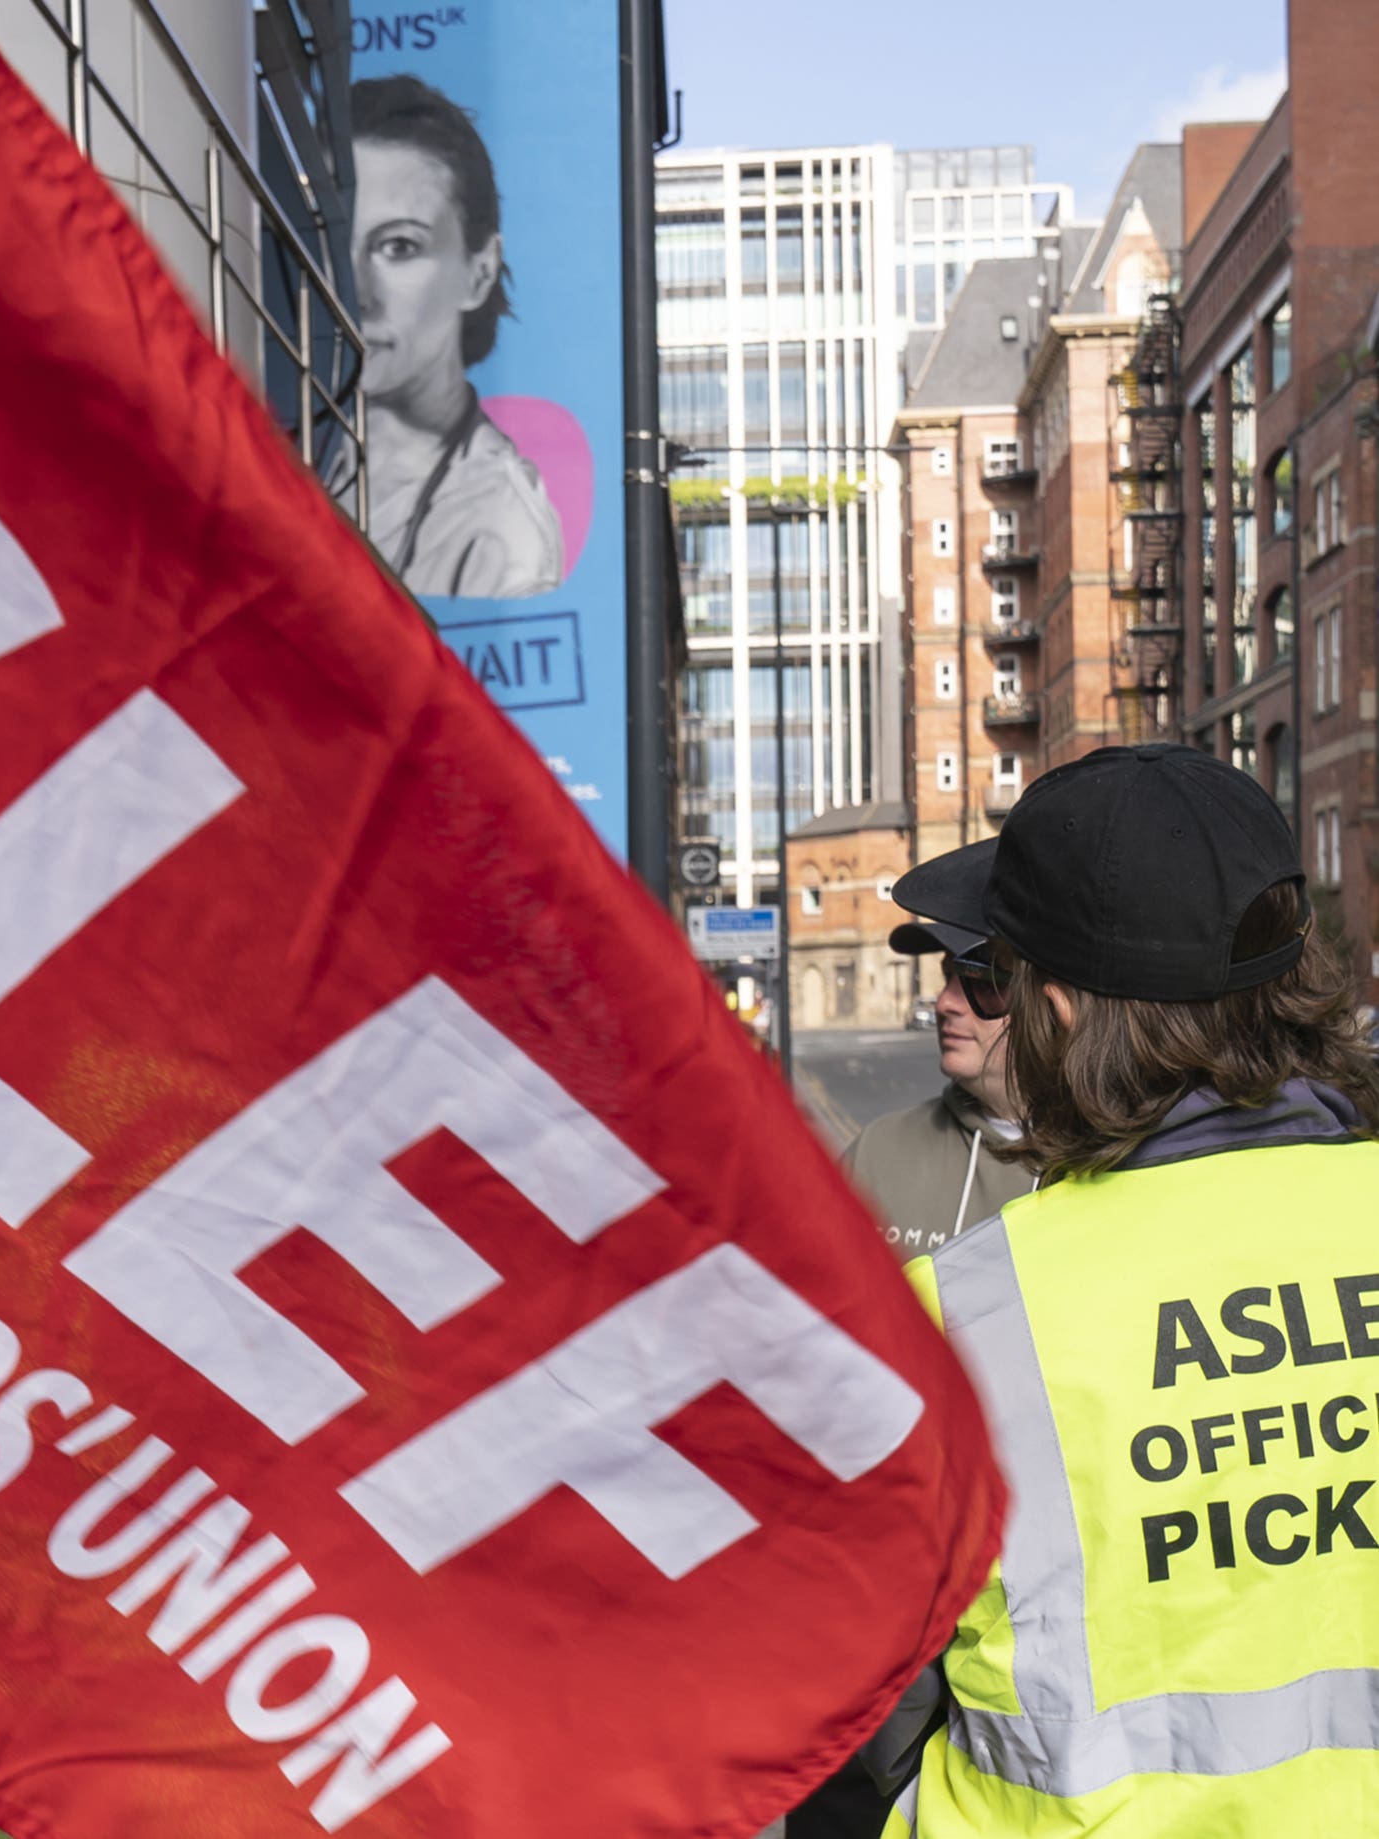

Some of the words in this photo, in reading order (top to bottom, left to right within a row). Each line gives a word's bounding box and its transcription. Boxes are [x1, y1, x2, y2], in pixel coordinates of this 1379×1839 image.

[466, 637, 561, 688] AIT
[877, 1226, 946, 1249] OMM
[1152, 1273, 1379, 1390] ASLE
[1130, 1392, 1379, 1483] OFFIC
[1141, 1480, 1379, 1583] PICK
[47, 1435, 453, 1834] UNION
